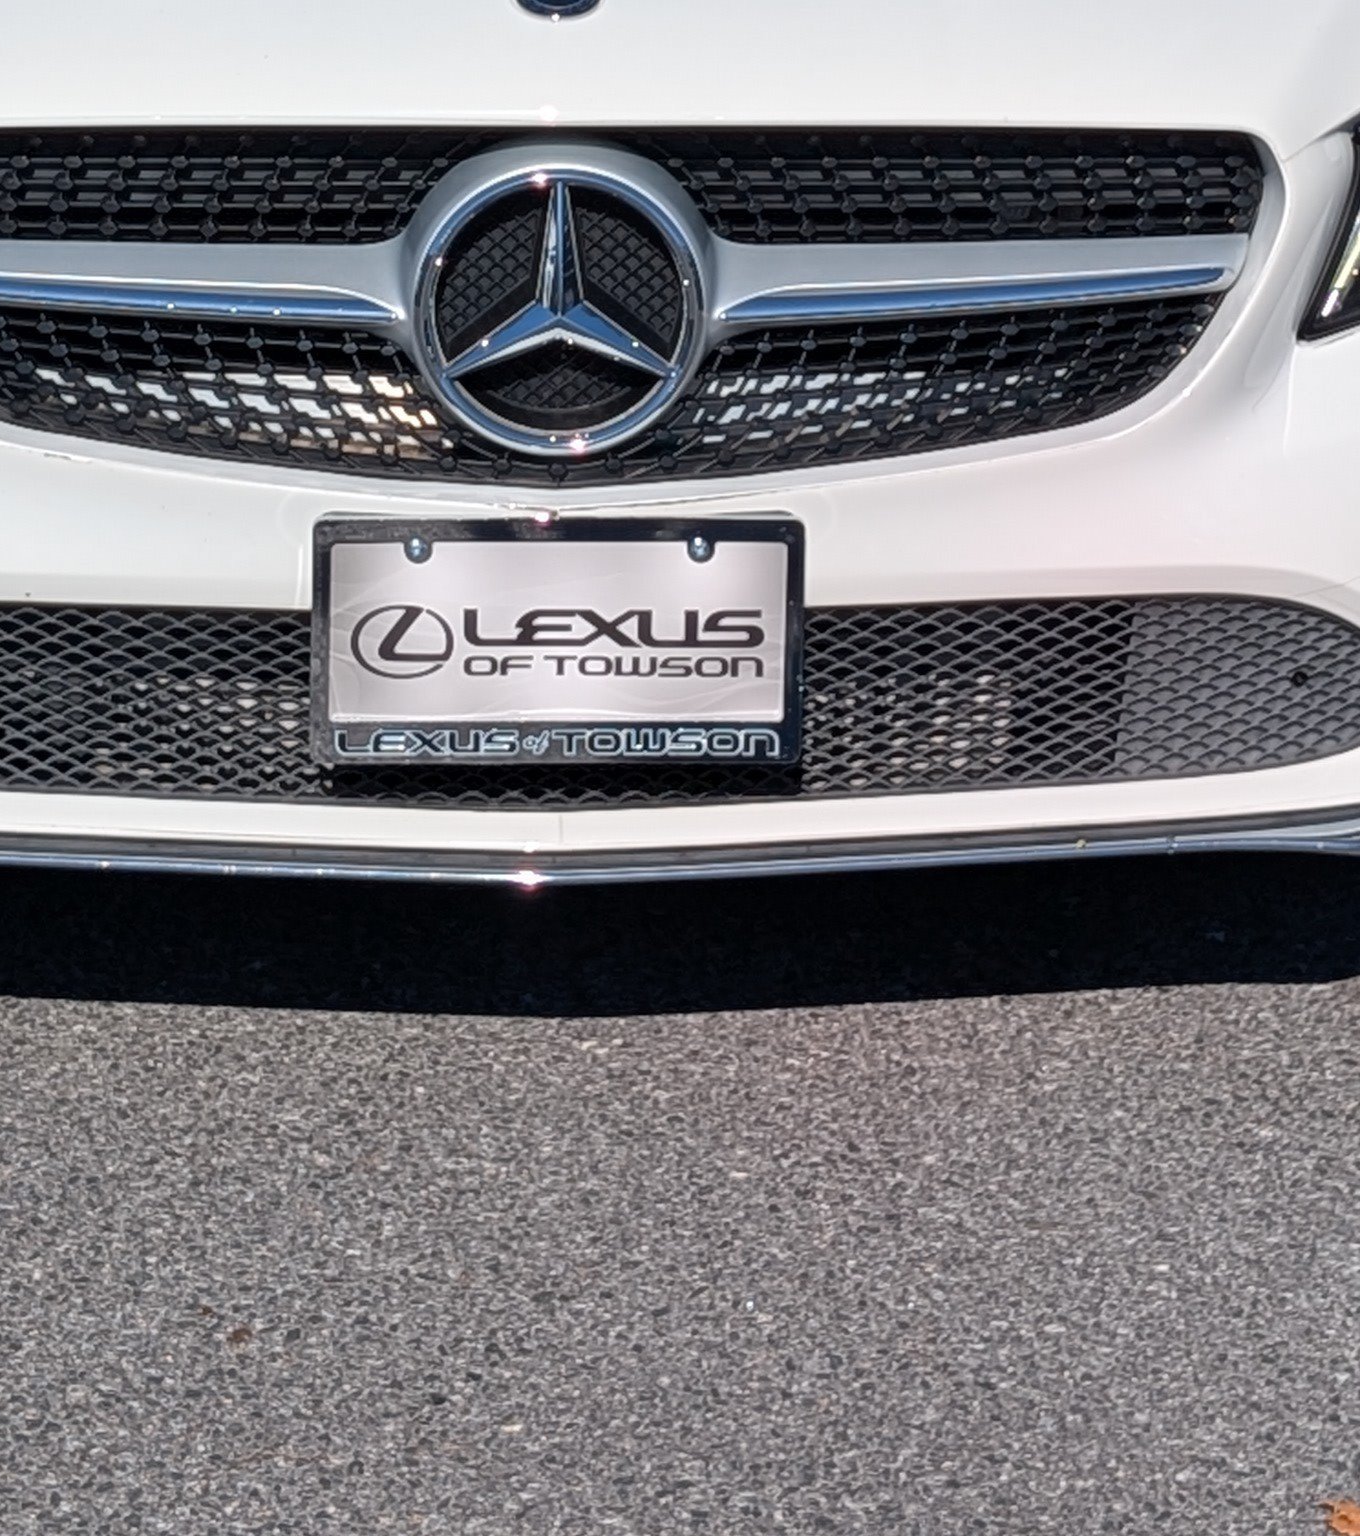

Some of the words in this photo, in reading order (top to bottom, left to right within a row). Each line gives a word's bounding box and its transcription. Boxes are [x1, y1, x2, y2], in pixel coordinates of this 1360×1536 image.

[463, 608, 765, 649] LEXUS
[463, 655, 534, 676] OF
[543, 655, 764, 678] TOWSON
[334, 728, 519, 756] LEXUS
[522, 729, 550, 756] of
[551, 728, 781, 757] TOWSON
